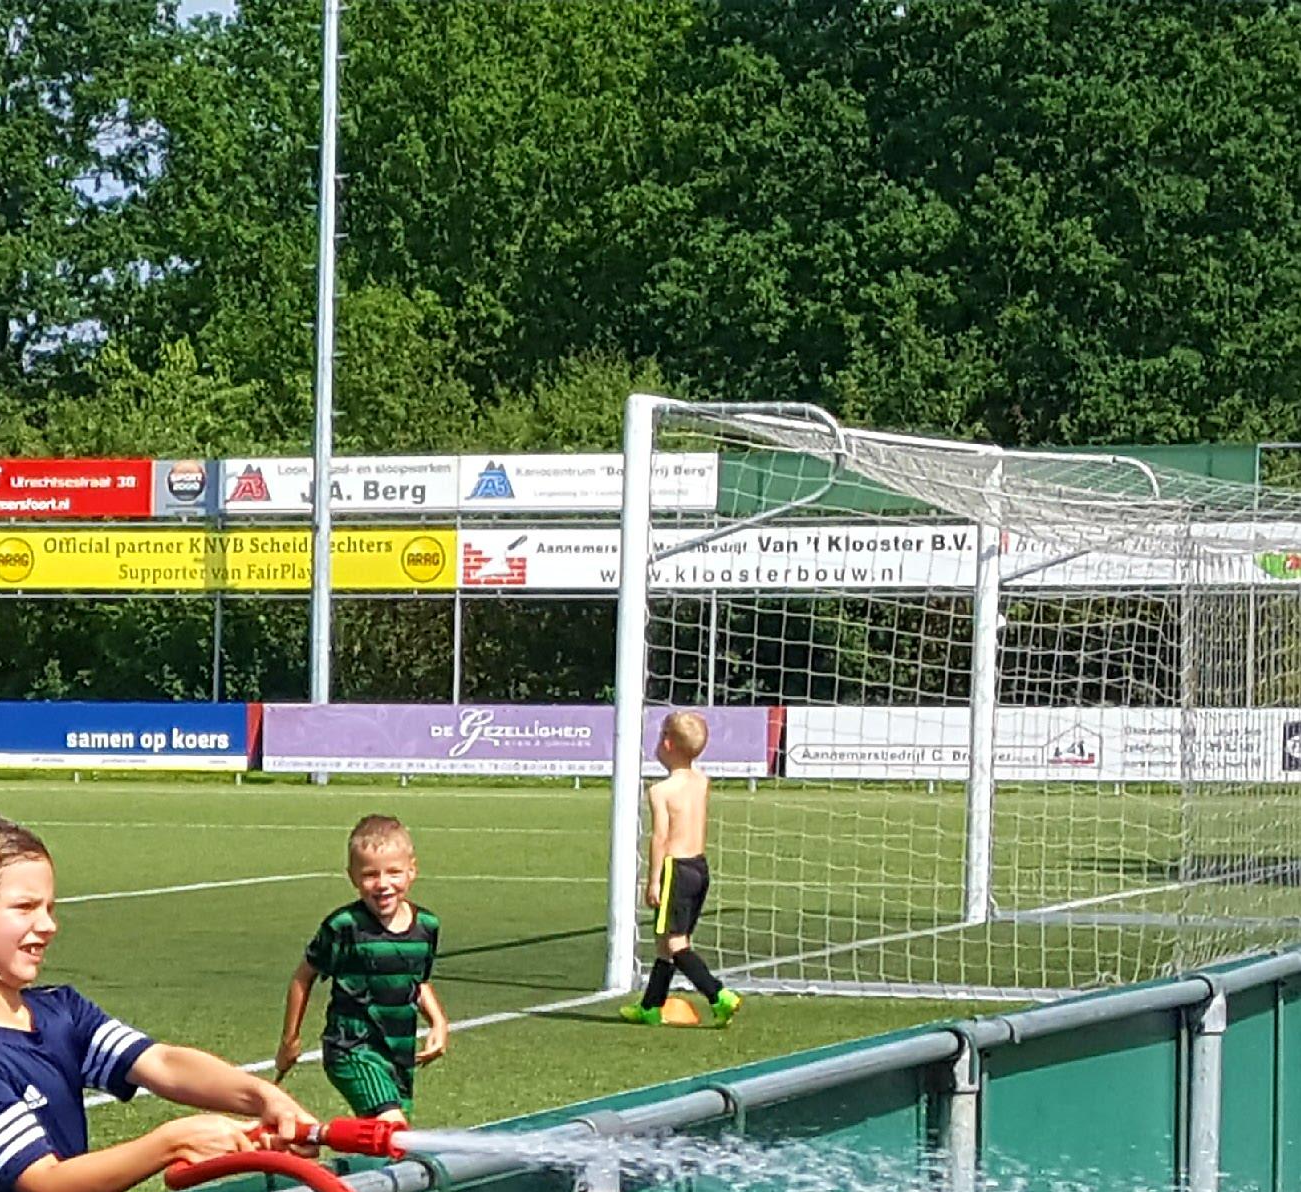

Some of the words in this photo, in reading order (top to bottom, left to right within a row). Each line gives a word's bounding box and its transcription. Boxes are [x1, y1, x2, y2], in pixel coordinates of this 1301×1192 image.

[363, 479, 426, 505] Berg
[43, 537, 110, 554] Official
[115, 540, 184, 558] partner
[189, 537, 244, 553] KNVB
[757, 536, 798, 552] Van
[827, 534, 924, 552] Klooster
[931, 533, 973, 551] B.V.
[406, 552, 440, 567] ARAG
[118, 564, 206, 584] Supporter
[211, 567, 242, 580] van
[66, 731, 134, 749] samen
[140, 731, 166, 752] op
[172, 728, 230, 749] koers
[431, 726, 454, 737] DE
